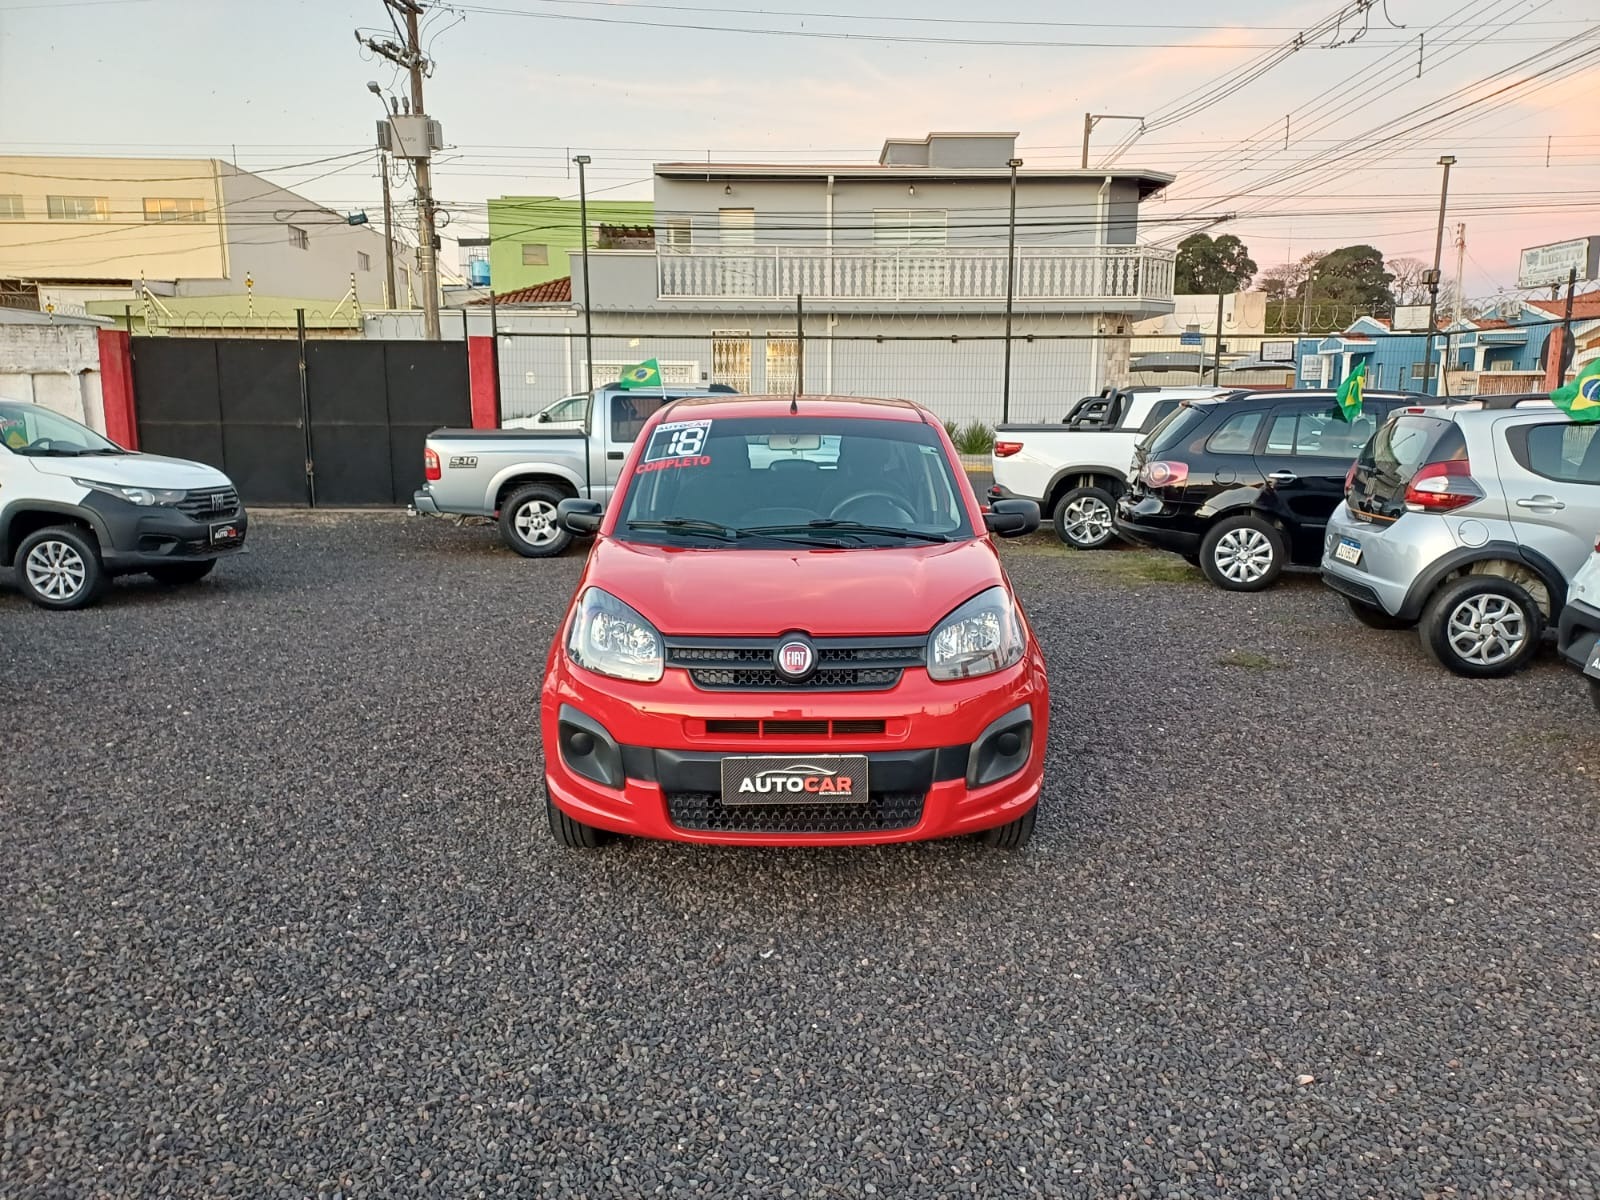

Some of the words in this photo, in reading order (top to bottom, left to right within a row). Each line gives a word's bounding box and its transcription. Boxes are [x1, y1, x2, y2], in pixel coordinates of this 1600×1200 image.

[657, 421, 710, 431] AUTOCAR
[668, 428, 704, 454] 18
[635, 456, 711, 474] COMPLETO
[214, 529, 237, 538] AUTO
[787, 651, 805, 666] FIAT
[1591, 657, 1600, 670] A
[738, 777, 852, 793] AUTOCAR
